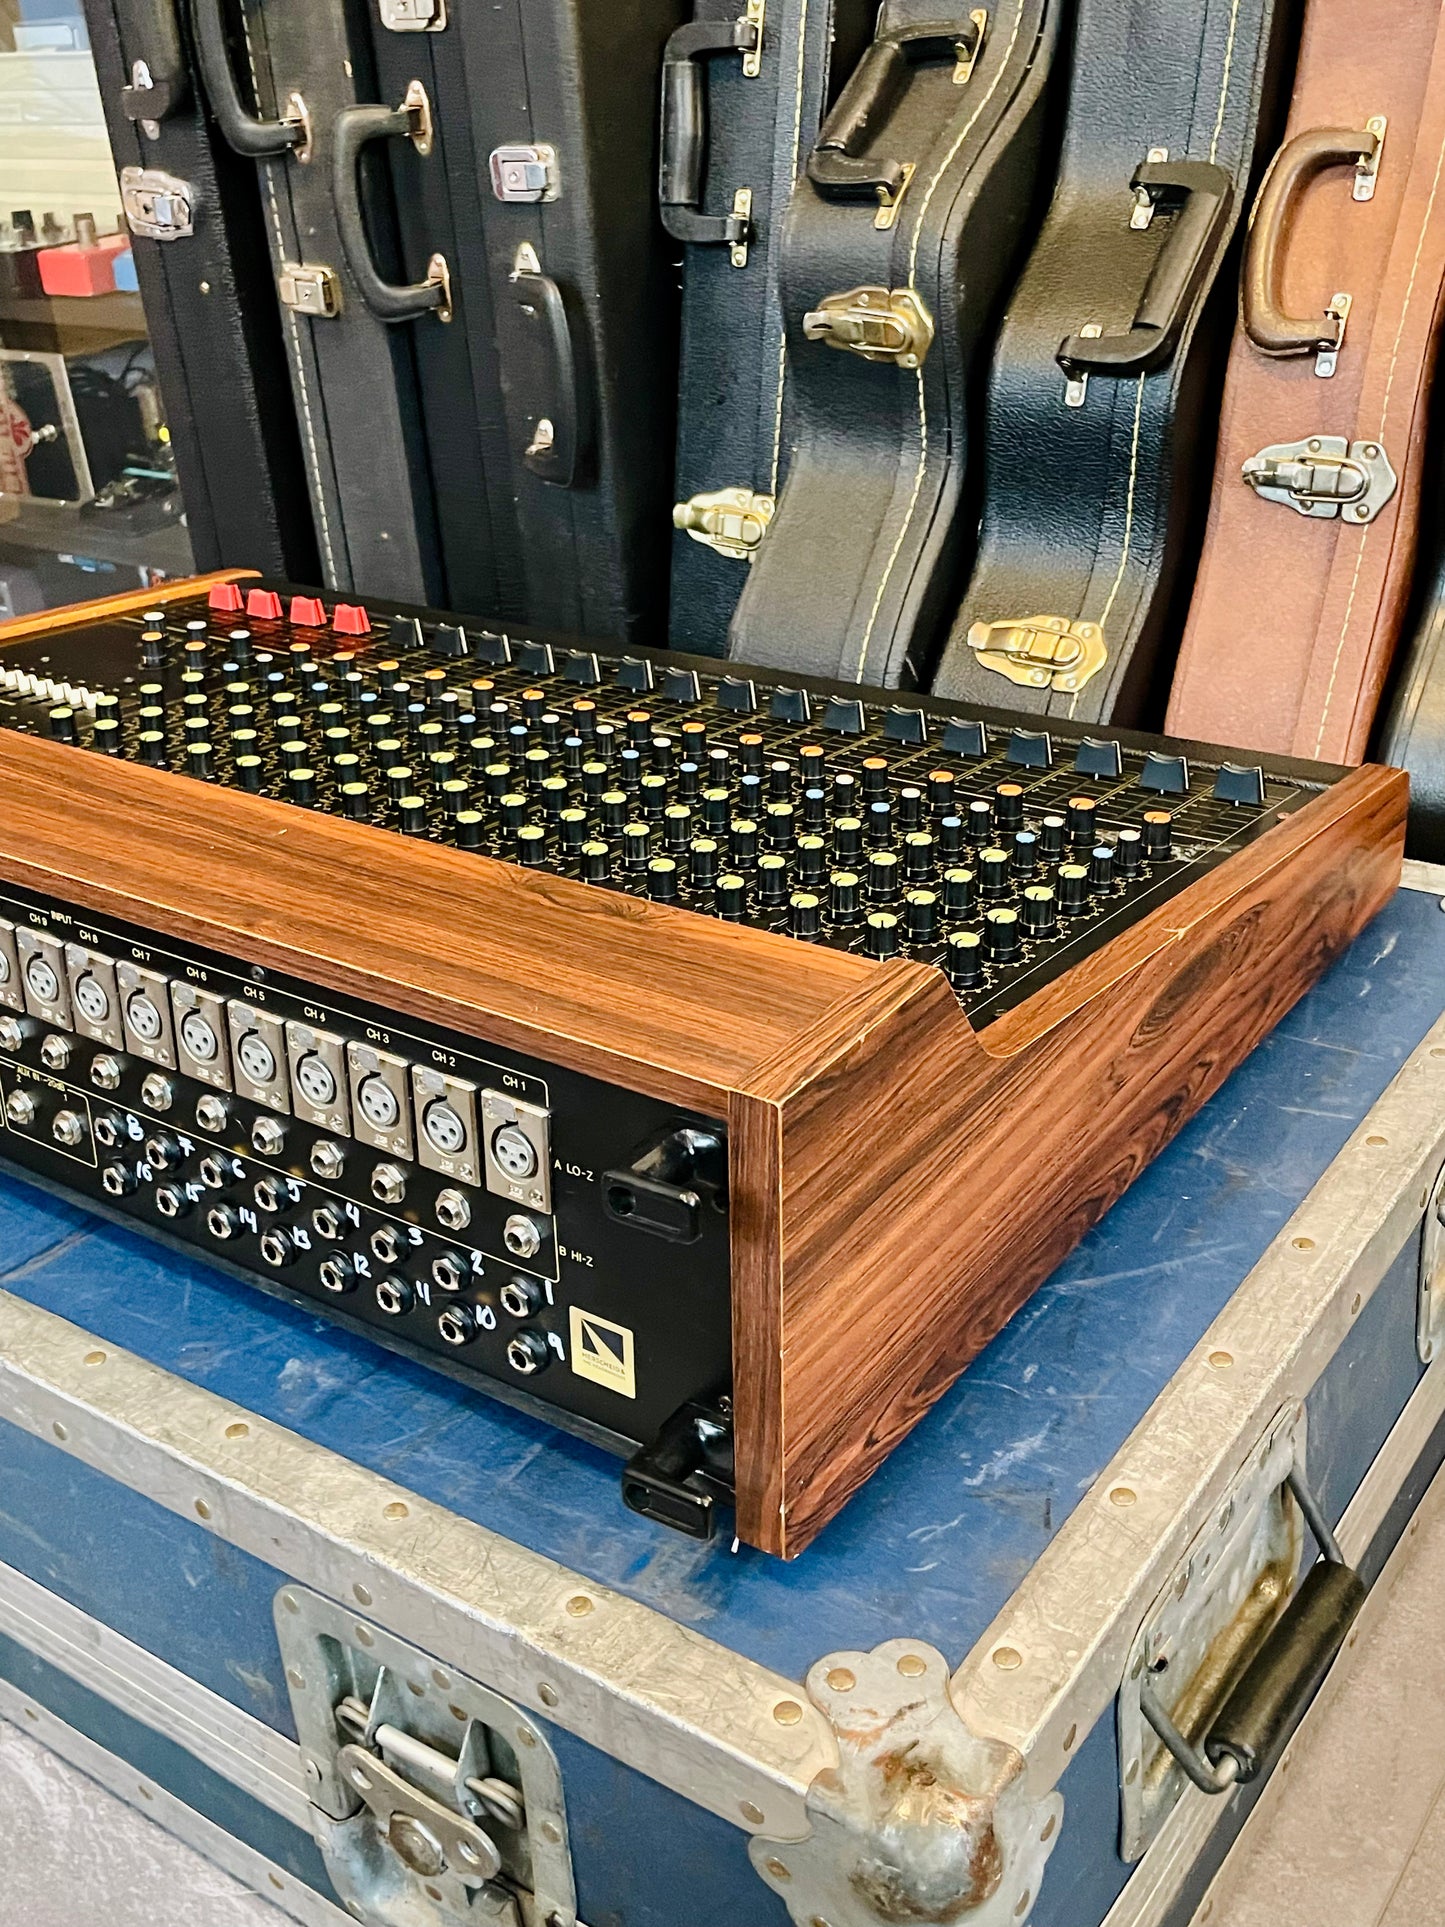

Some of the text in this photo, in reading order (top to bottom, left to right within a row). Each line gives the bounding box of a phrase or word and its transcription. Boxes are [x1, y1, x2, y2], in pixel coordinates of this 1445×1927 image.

[29, 912, 41, 924] CH
[79, 929, 99, 944] CH 8
[132, 947, 151, 962] CH 7
[186, 966, 208, 982] CH 6
[243, 986, 266, 1001] CH 5
[304, 1006, 327, 1022] CH 4
[366, 1027, 390, 1044] CH 3
[431, 1050, 456, 1067] CH 2
[502, 1074, 527, 1091] CH 1
[126, 1113, 144, 1141] 8
[136, 1160, 153, 1181] 16
[231, 1158, 246, 1179] 6
[554, 1159, 594, 1182] A LO-Z
[286, 1177, 307, 1203] 5
[239, 1206, 258, 1234] 14
[345, 1202, 360, 1228] 4
[408, 1227, 424, 1246] 3
[353, 1252, 372, 1279] 12
[470, 1250, 485, 1276] 2
[558, 1245, 594, 1268] B HI-Z
[415, 1279, 431, 1306] 11
[544, 1278, 554, 1305] 1
[475, 1304, 497, 1331] 10
[547, 1331, 565, 1361] 9
